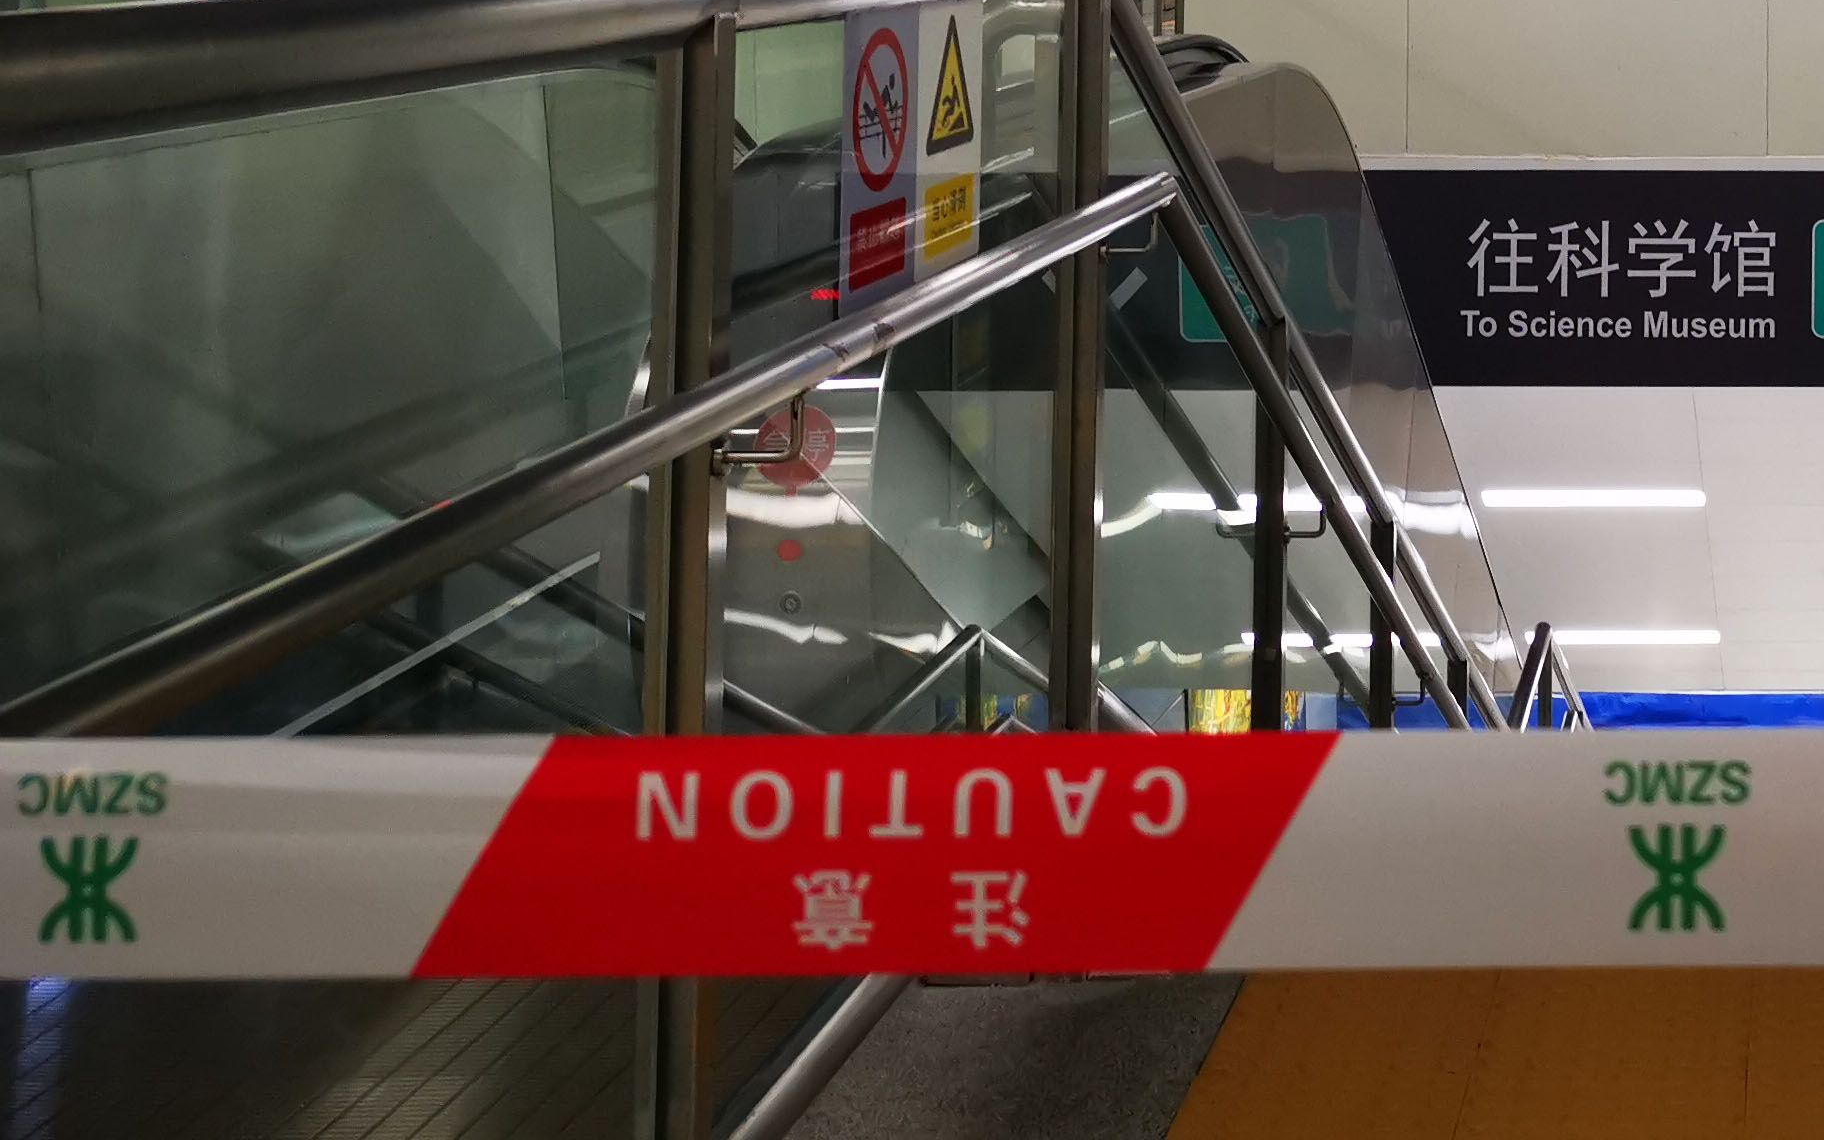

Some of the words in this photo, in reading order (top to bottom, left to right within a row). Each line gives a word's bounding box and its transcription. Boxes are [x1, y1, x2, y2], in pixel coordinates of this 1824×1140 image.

[1469, 221, 1776, 298] 往科学馆
[1461, 310, 1497, 337] To
[1508, 309, 1632, 338] Science
[1643, 310, 1776, 338] Museum
[18, 772, 169, 817] SZMC
[640, 769, 1187, 840] CAUTION
[1604, 759, 1750, 807] SZMC
[797, 873, 1029, 950] 注意
